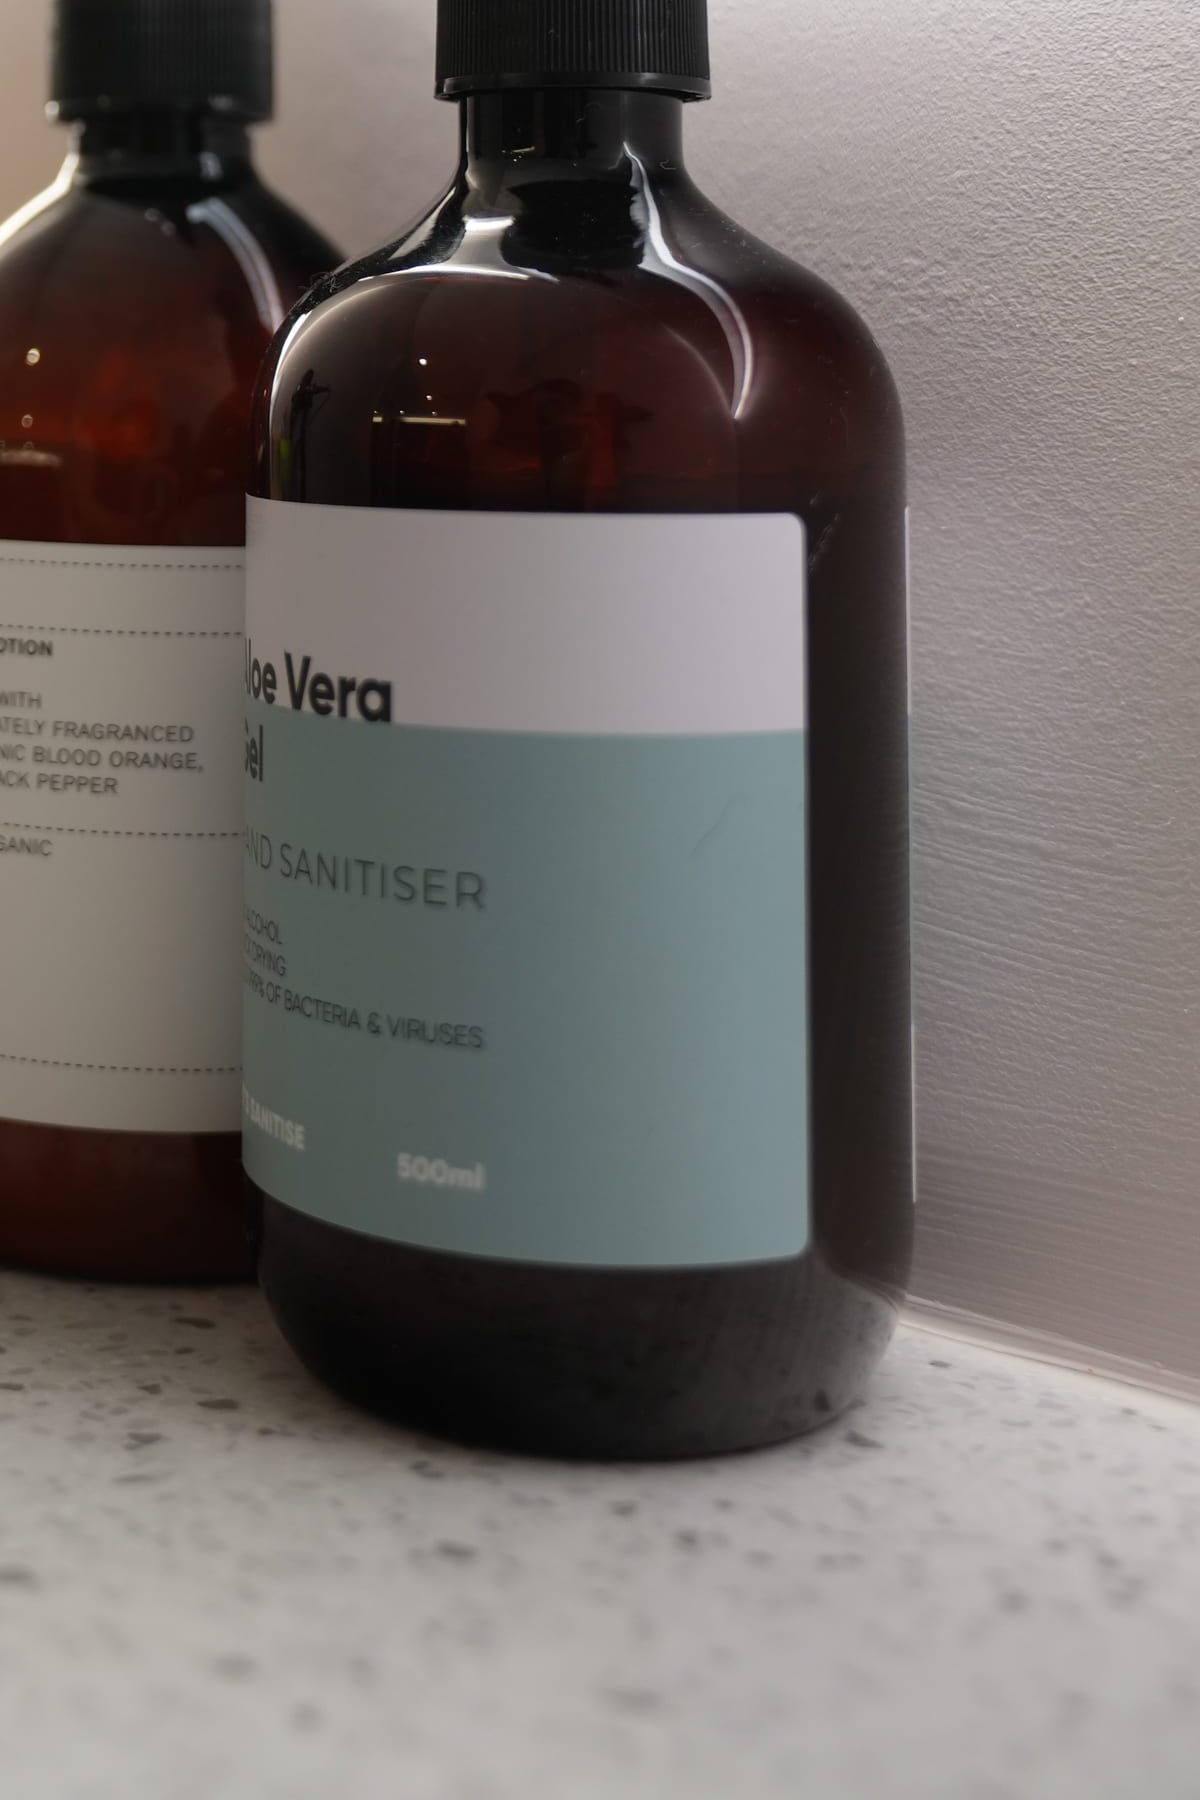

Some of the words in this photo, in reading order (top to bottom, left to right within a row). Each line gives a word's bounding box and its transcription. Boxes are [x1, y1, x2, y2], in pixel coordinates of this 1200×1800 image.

[284, 651, 392, 723] Vera
[53, 720, 195, 743] FRAGRANCED
[32, 745, 101, 767] BLOOD
[109, 750, 204, 774] ORANGE,
[36, 772, 120, 795] PEPPER
[279, 842, 487, 909] SANITISER
[266, 981, 282, 1004] OF
[284, 988, 361, 1029] BACTERIA
[366, 1011, 381, 1036] &
[387, 1015, 484, 1049] VIRUSES
[397, 1153, 486, 1191] 500ml
